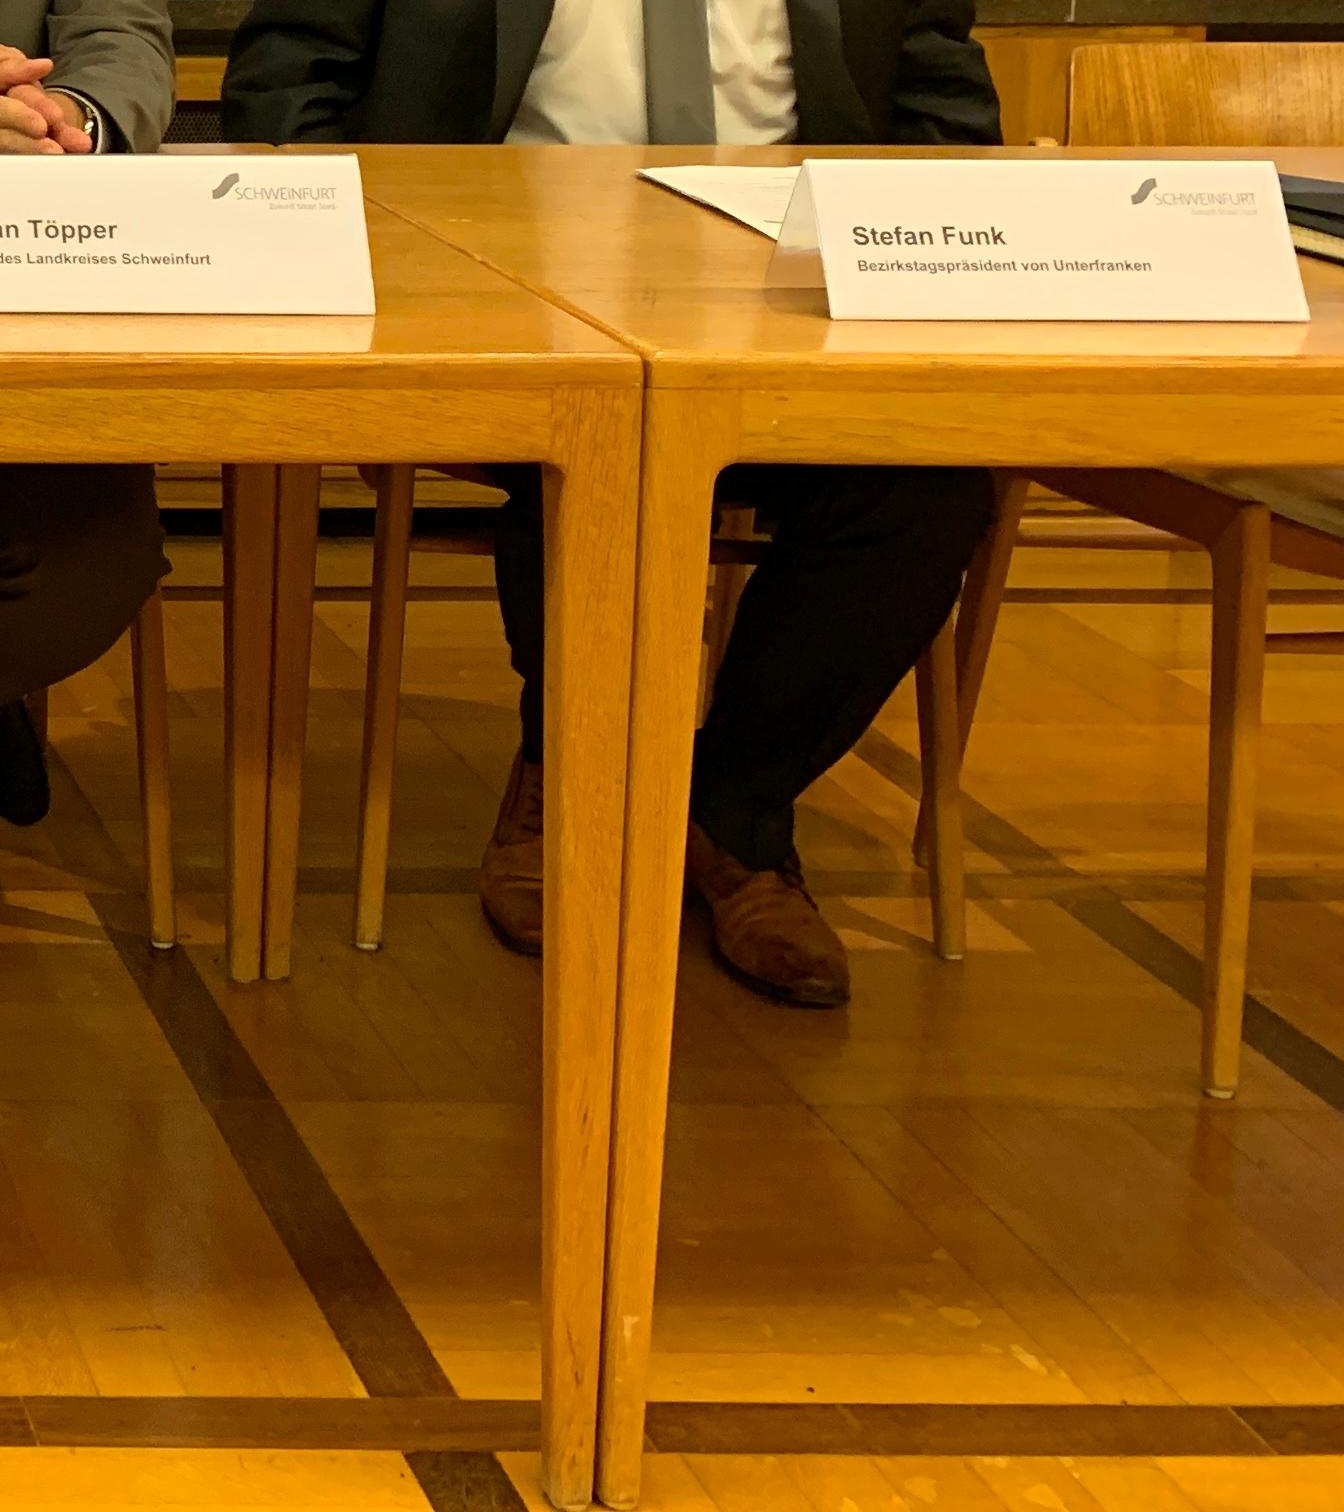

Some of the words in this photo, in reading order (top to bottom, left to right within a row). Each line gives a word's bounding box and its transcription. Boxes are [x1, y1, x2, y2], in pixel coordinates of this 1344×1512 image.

[234, 187, 337, 200] SCHWEINFURT
[1153, 192, 1256, 206] SCHWEINFURT
[27, 219, 118, 243] Töpper
[851, 225, 934, 246] Stefan
[942, 225, 1007, 246] Funk
[26, 252, 117, 265] Landkreises
[121, 252, 211, 265] Schweinfurt
[857, 259, 1018, 275] Bezirkstagspräsident
[1020, 261, 1049, 272] von
[1053, 259, 1153, 272] Unterfranken
